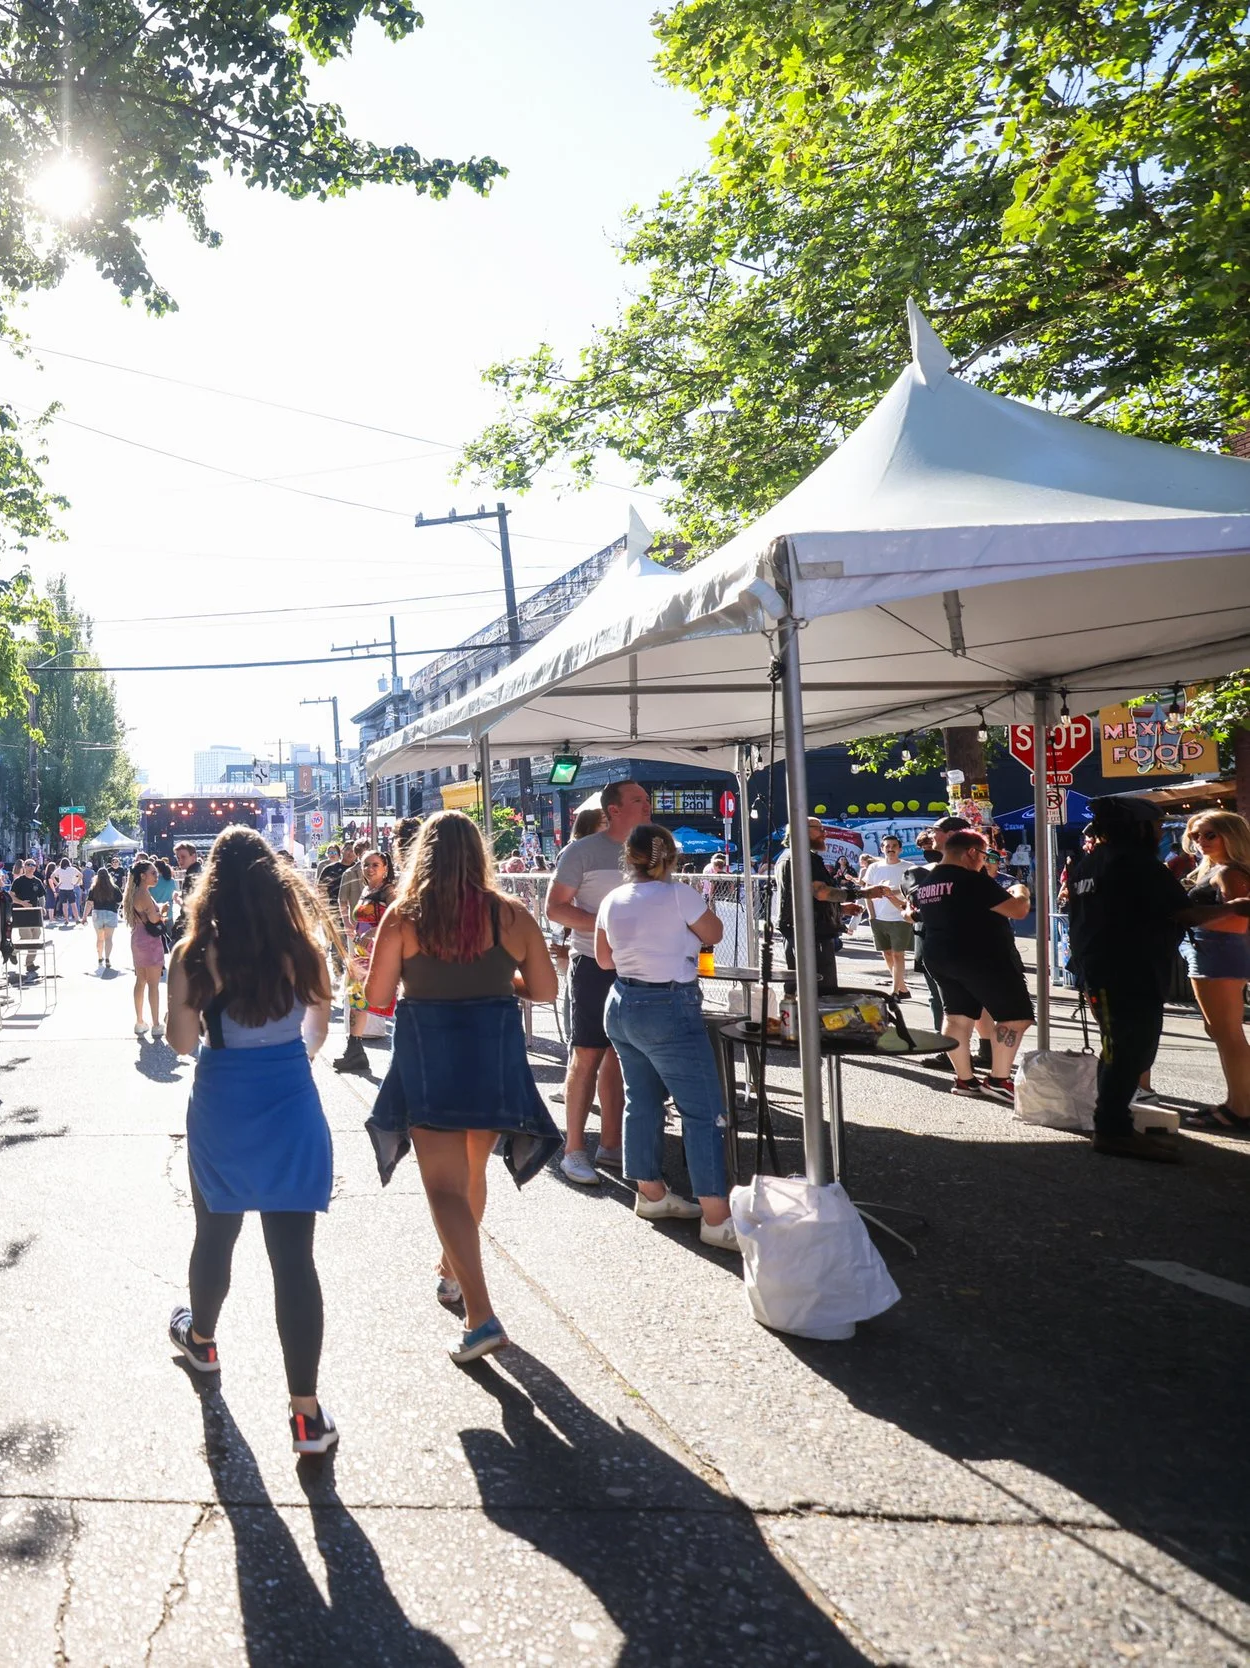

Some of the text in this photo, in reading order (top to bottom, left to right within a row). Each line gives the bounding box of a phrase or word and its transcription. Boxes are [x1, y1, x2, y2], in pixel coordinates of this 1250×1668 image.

[1015, 724, 1087, 750] SOP
[1103, 719, 1202, 741] MEXIC
[1112, 742, 1204, 766] FOOD
[682, 793, 710, 801] TAVERN
[682, 801, 706, 810] POOL
[825, 842, 860, 863] TERLOO
[917, 882, 954, 899] ECURITY
